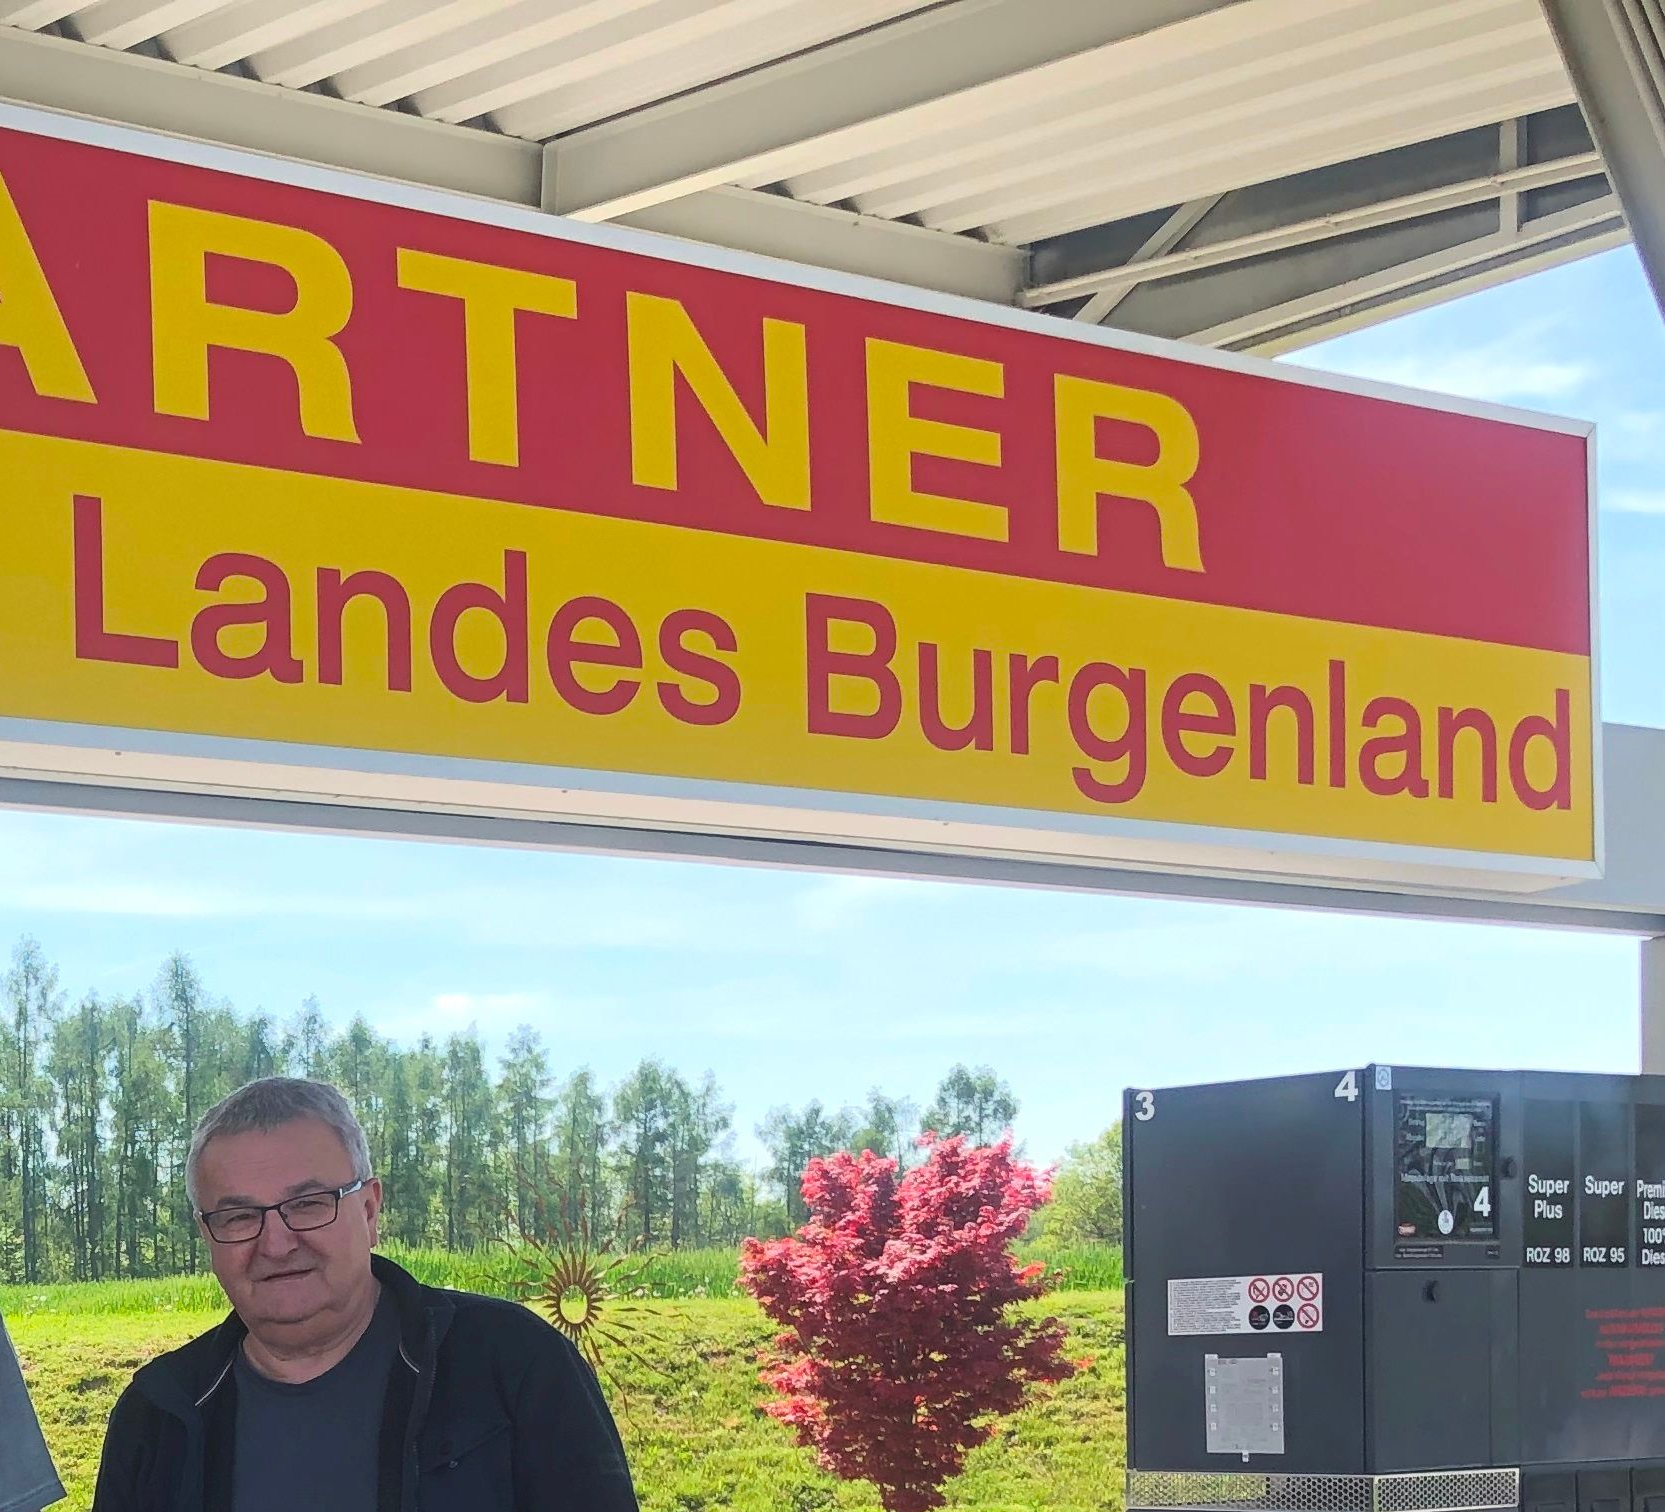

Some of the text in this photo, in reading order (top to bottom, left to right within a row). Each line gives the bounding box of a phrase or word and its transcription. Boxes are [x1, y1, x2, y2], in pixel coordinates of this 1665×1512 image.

[72, 495, 742, 726] Landes
[806, 593, 1573, 812] Burgenland
[1335, 1070, 1359, 1102] 4
[1135, 1091, 1155, 1121] 3
[1528, 1174, 1570, 1198] Super
[1584, 1175, 1625, 1198] Super
[1473, 1186, 1491, 1217] 4
[1534, 1200, 1563, 1219] Plus
[1526, 1247, 1571, 1263] ROZ 98
[1583, 1247, 1625, 1263] ROZ 95
